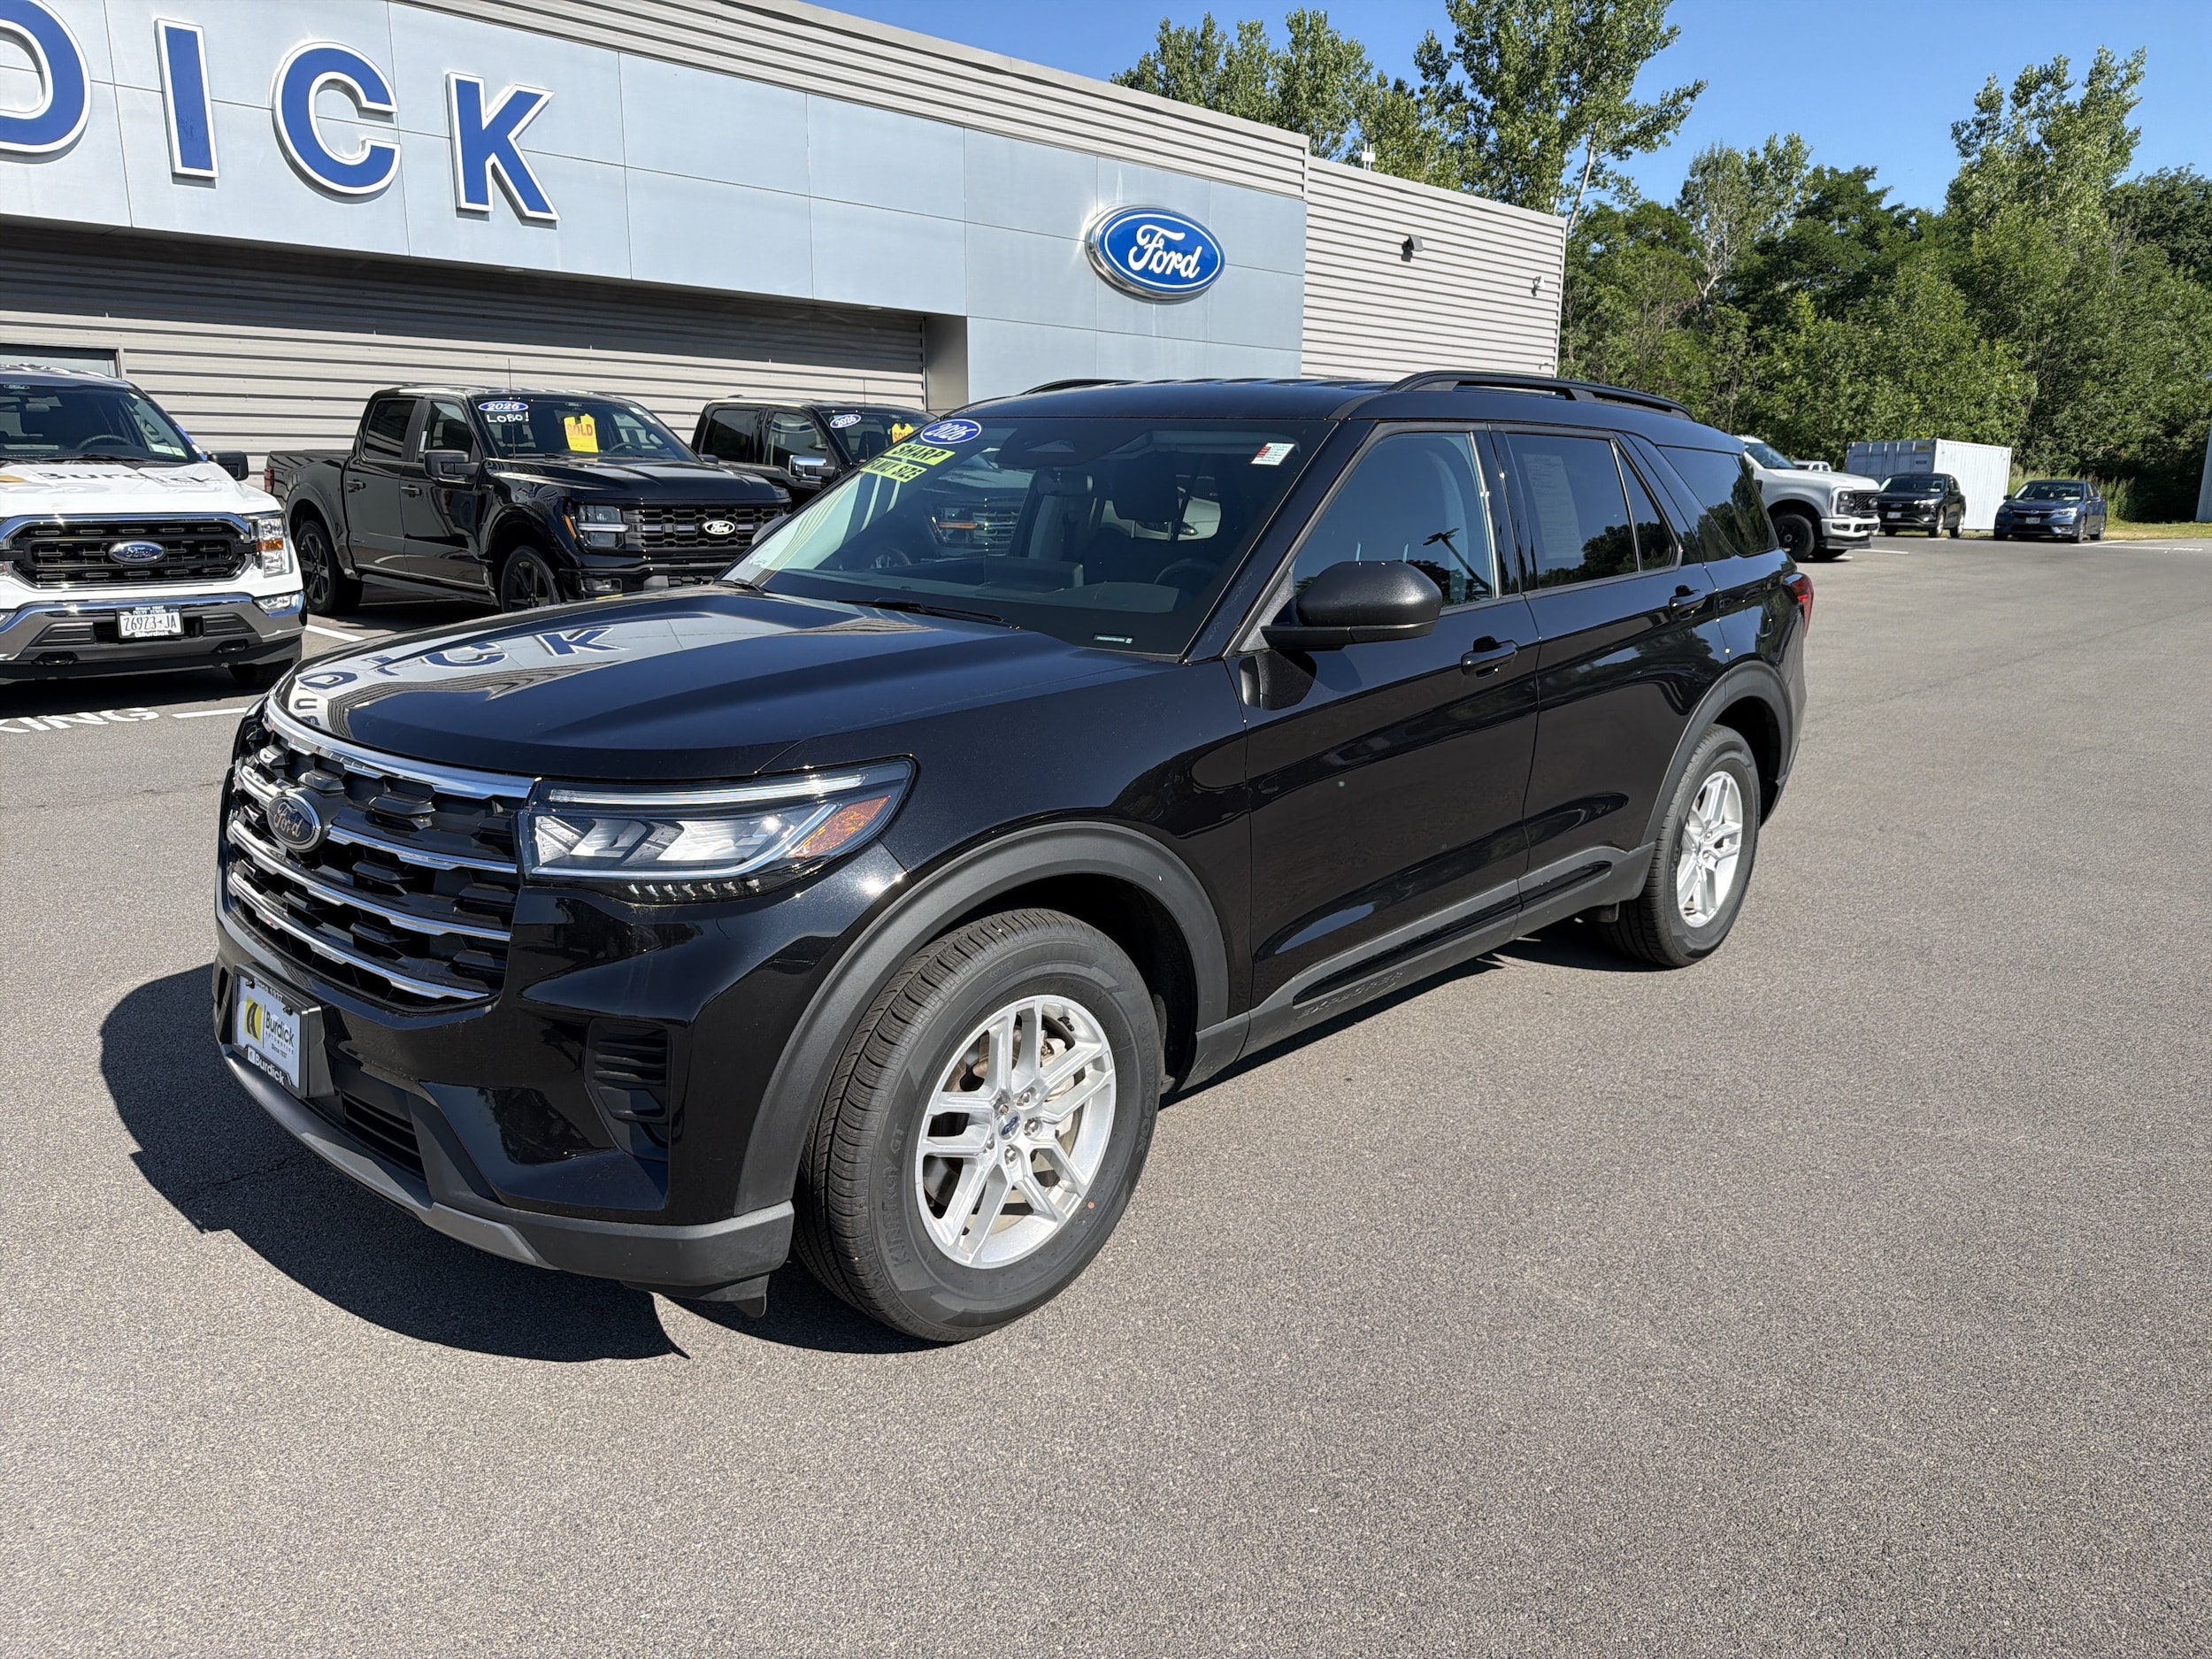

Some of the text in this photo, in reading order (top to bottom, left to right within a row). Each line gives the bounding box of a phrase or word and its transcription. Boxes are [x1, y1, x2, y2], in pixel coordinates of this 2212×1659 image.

[1128, 224, 1202, 279] Ford
[566, 423, 594, 436] SOLD
[835, 416, 857, 427] 2026
[924, 422, 978, 441] 2026
[891, 444, 947, 461] SHARP
[890, 465, 924, 480] SIZE
[273, 802, 303, 838] Ford
[265, 1010, 295, 1048] Burdick
[255, 1053, 285, 1086] Burdick
[890, 1122, 904, 1154] GT
